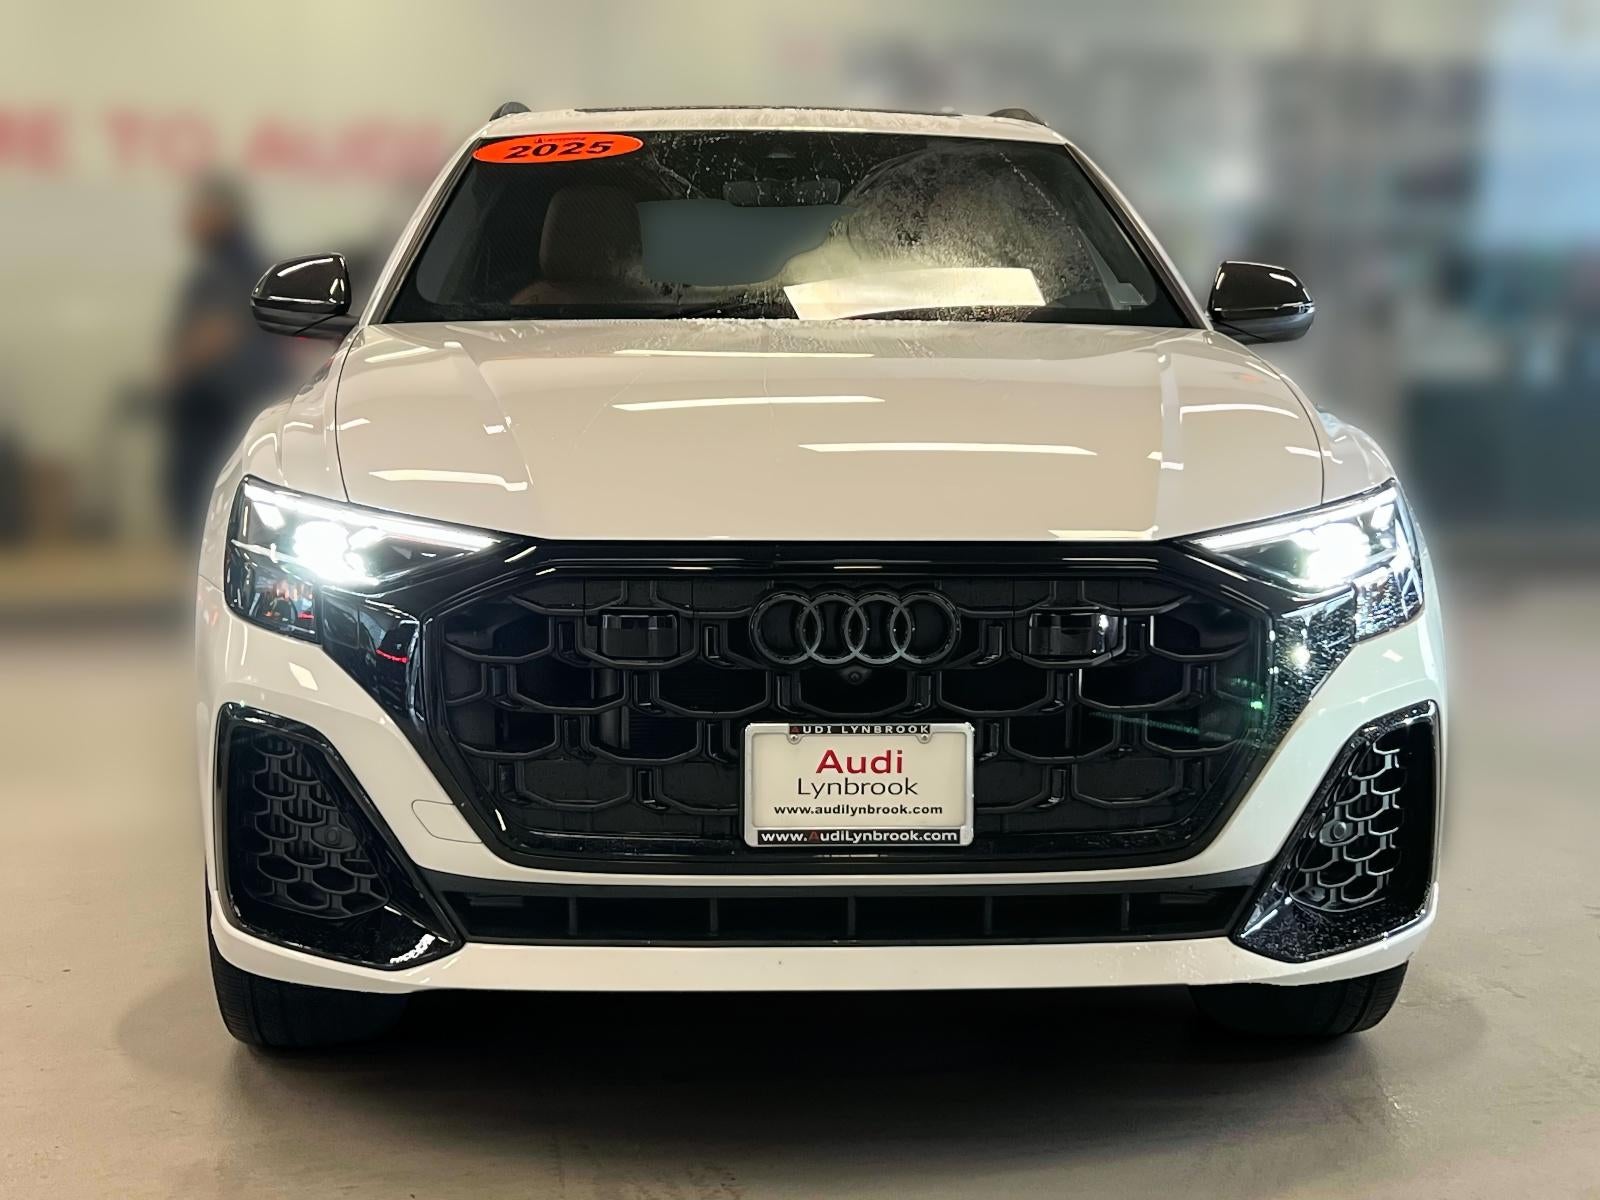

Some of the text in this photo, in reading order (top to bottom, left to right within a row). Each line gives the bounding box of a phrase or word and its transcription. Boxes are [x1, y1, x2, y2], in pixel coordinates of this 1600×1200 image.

[504, 141, 613, 159] 2025
[791, 725, 930, 734] AUDI LYNBROOK
[815, 749, 903, 773] Audi
[797, 777, 918, 799] Lynbrook
[774, 804, 943, 817] www.audilynbrook.com
[761, 829, 957, 843] www.AudiLynbrook.com
